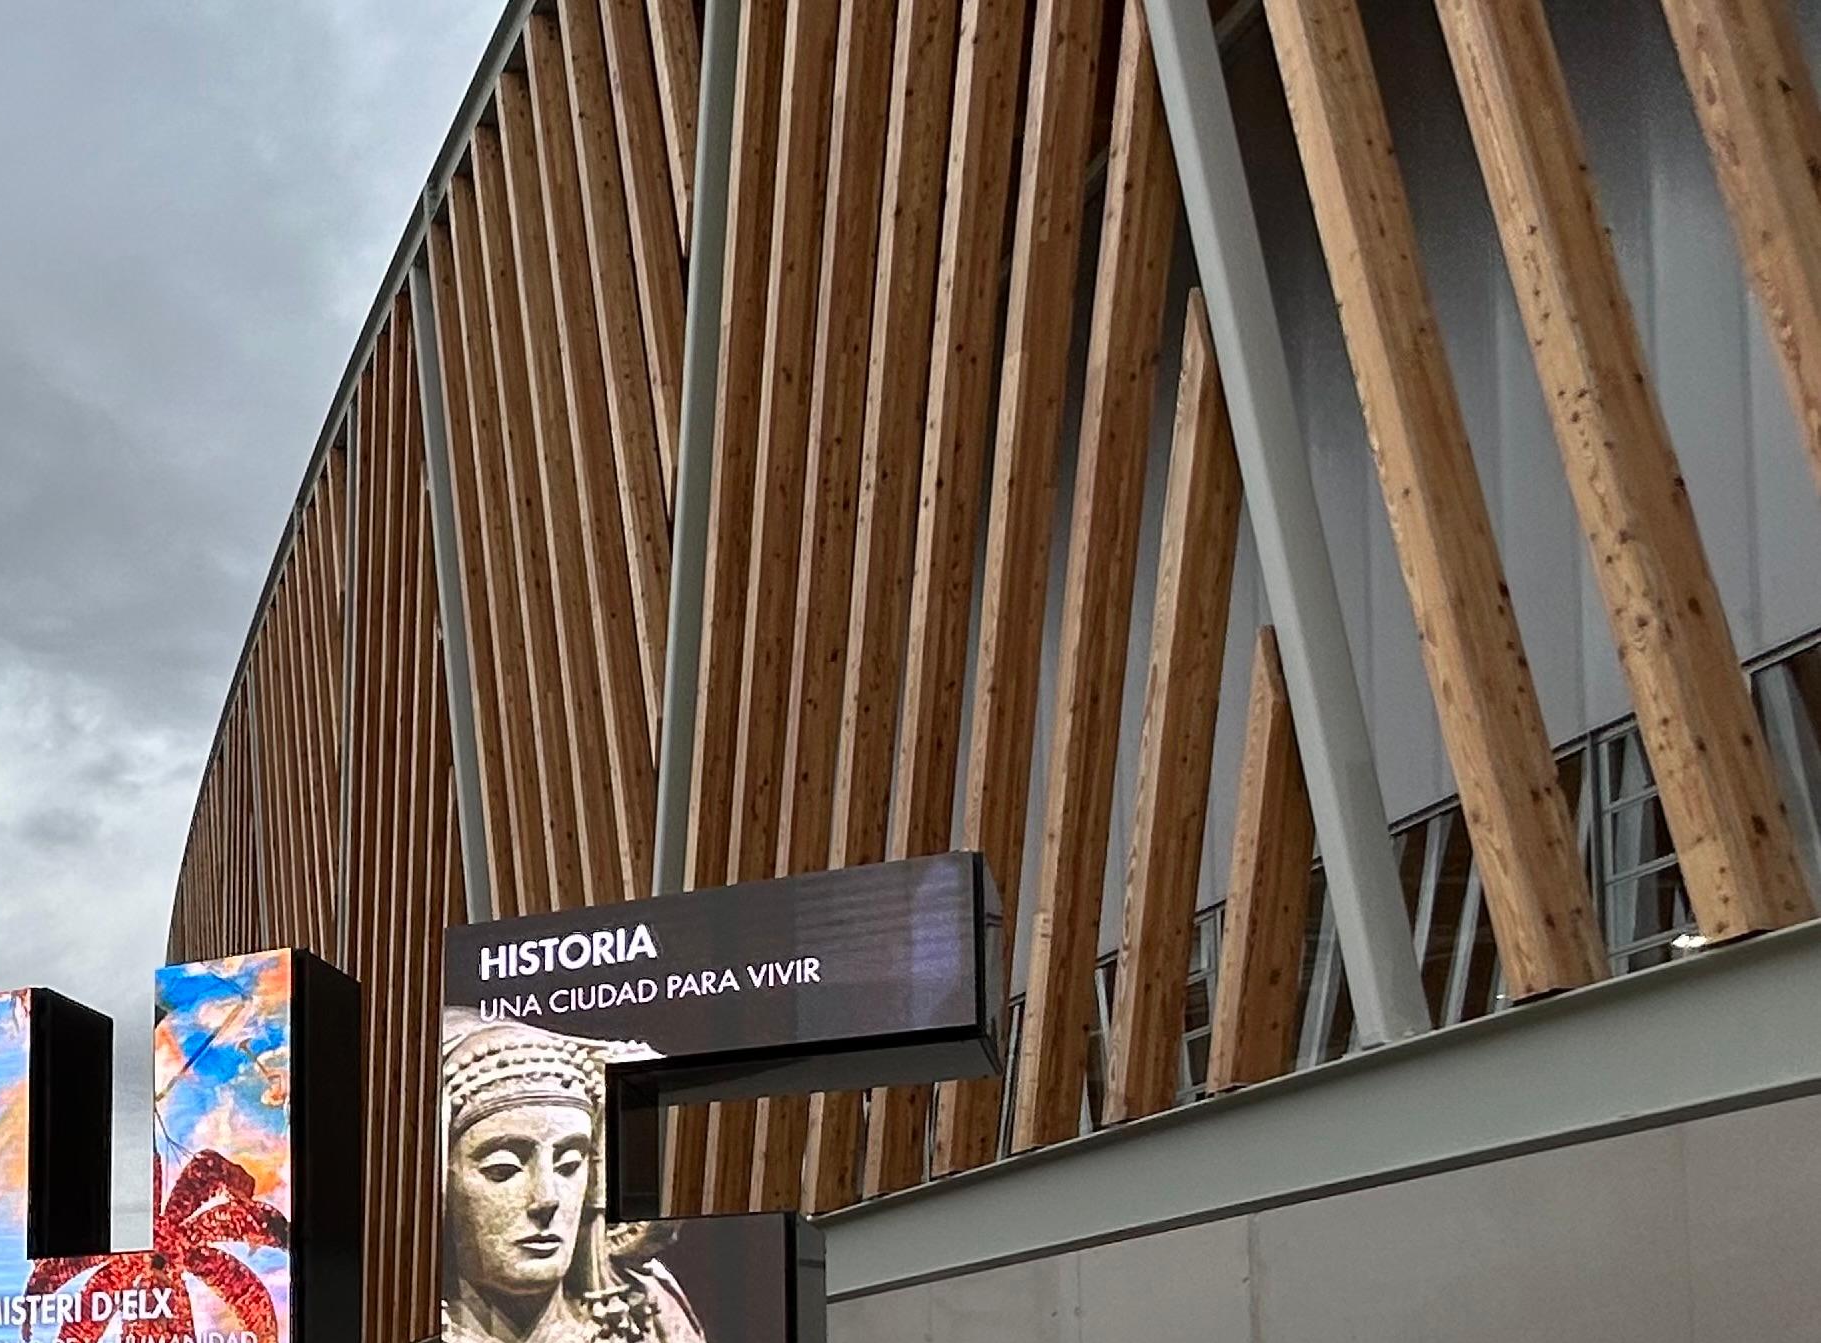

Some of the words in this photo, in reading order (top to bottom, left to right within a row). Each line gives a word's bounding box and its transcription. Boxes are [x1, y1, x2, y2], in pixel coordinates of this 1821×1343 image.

[480, 923, 658, 980] HISTORIA
[480, 995, 542, 1022] UNA
[549, 979, 658, 1014] CIUDAD
[666, 968, 740, 999] PARA
[747, 957, 821, 988] VIVIR
[92, 1288, 173, 1321] D'ELX
